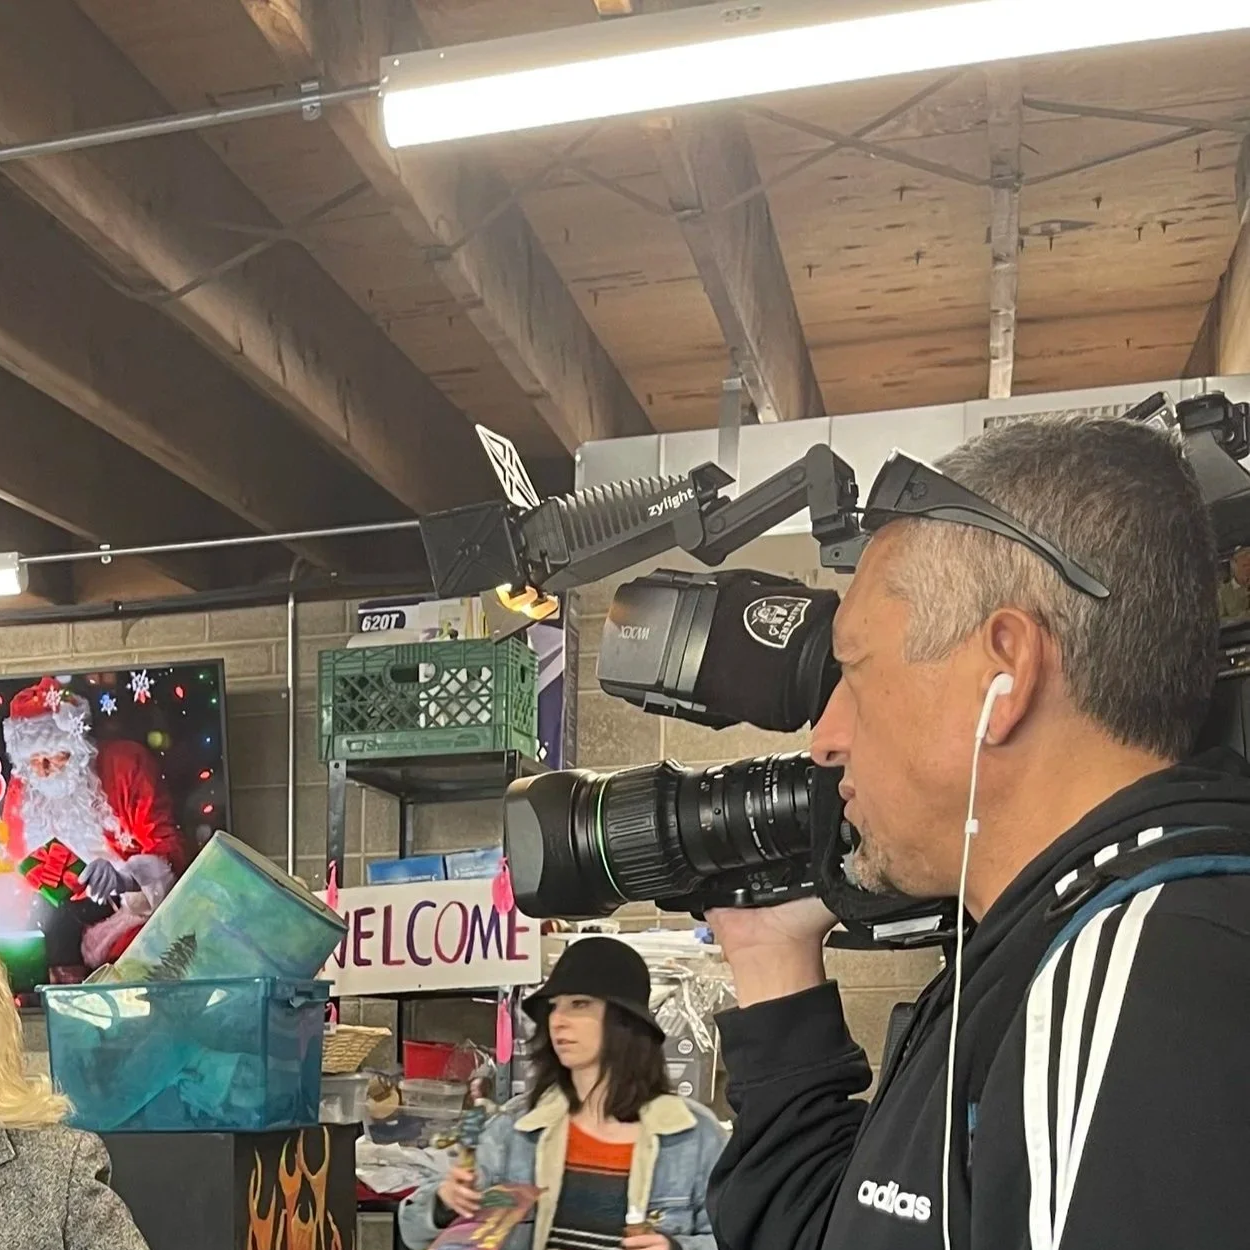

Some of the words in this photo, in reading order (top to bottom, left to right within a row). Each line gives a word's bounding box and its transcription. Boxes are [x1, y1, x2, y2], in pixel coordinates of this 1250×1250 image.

[648, 488, 695, 517] zylight
[361, 613, 400, 632] 620T
[857, 1180, 932, 1221] adidas
